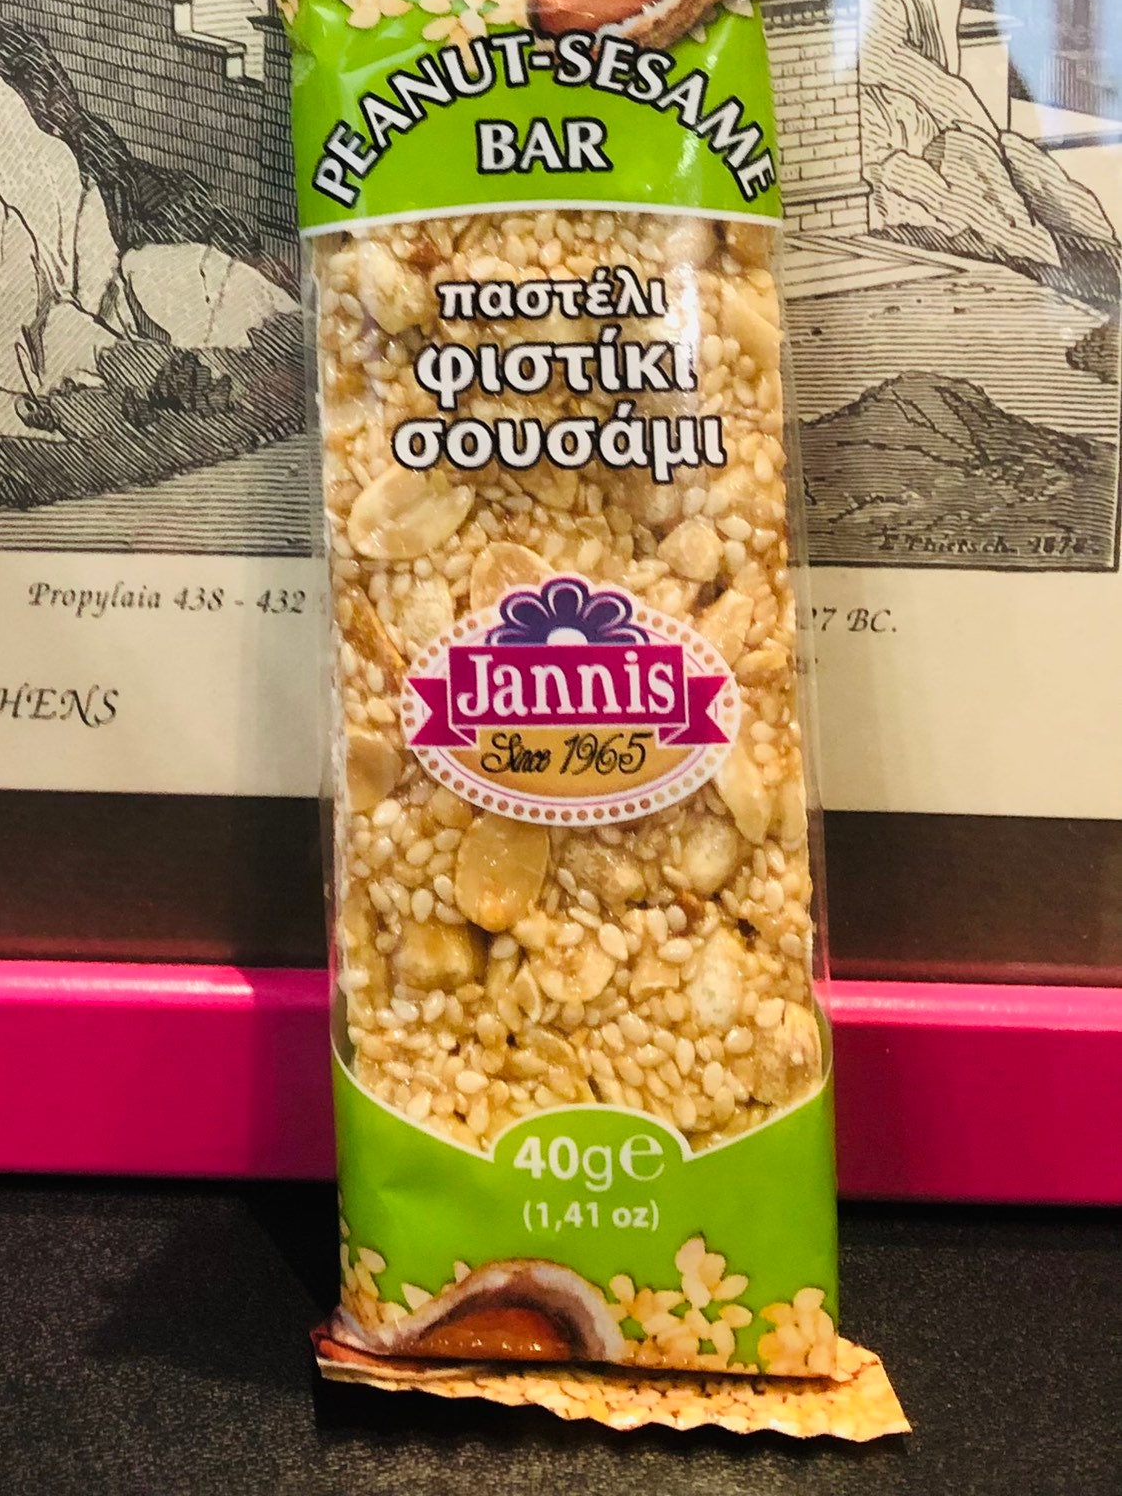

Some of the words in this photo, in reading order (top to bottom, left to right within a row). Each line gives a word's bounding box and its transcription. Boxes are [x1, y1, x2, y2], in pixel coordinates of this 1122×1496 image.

[313, 30, 776, 207] PEANUT-SESAME
[477, 118, 612, 174] BAR
[435, 266, 668, 320] παστέλι
[414, 325, 697, 408] φιστίκι
[391, 402, 727, 483] σουσάμι
[28, 580, 161, 619] Propylaia
[173, 586, 225, 612] 438
[256, 589, 306, 614] 432
[846, 607, 897, 633] BC.
[456, 650, 676, 718] Jannis
[558, 733, 654, 776] 1965
[522, 1200, 600, 1231] (1,41
[611, 1200, 661, 1231] oz)
